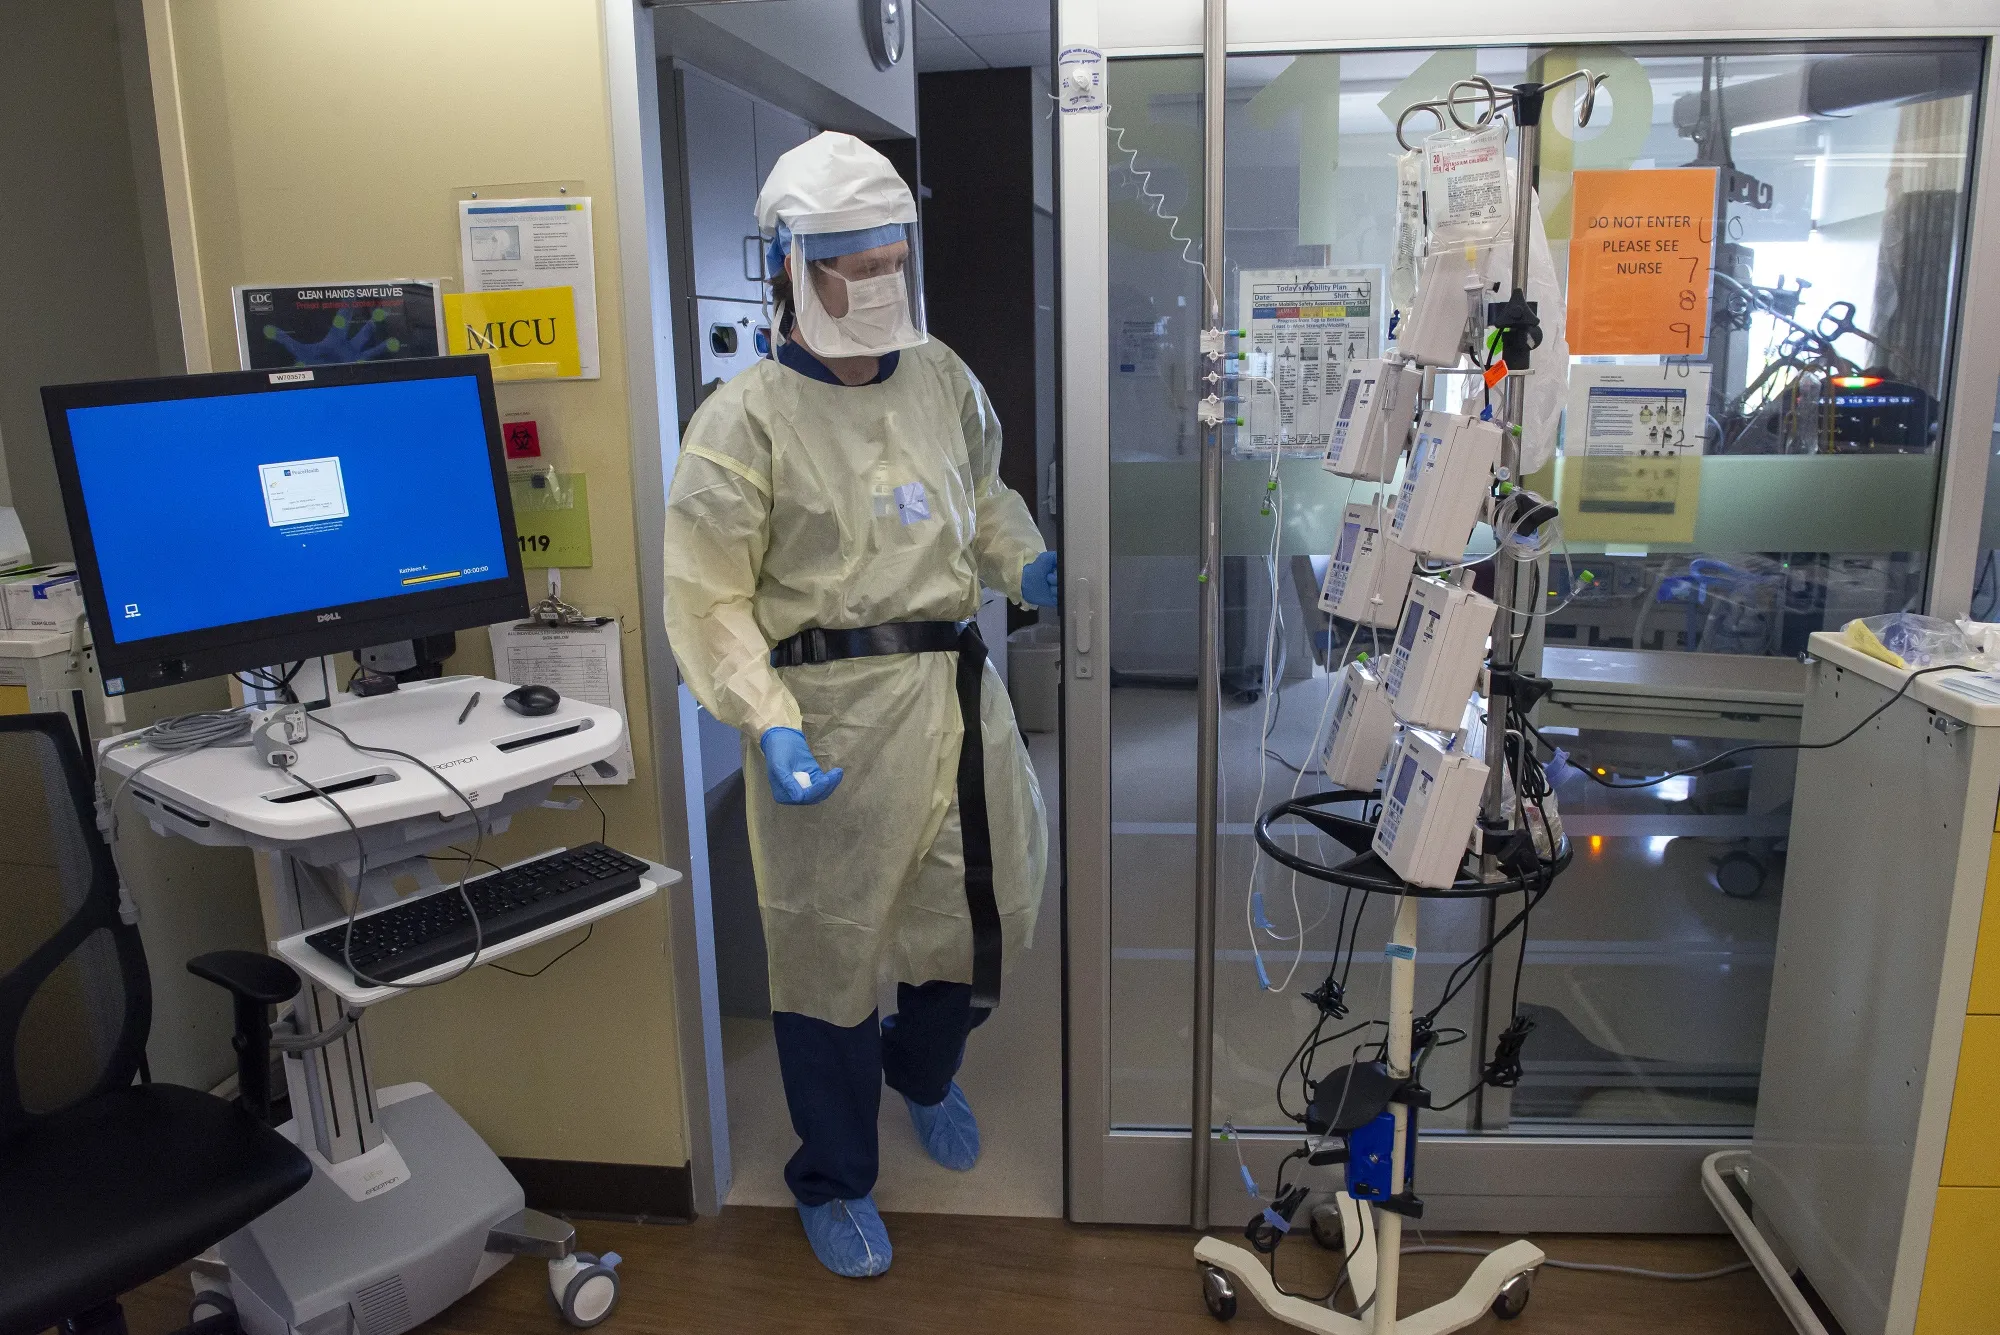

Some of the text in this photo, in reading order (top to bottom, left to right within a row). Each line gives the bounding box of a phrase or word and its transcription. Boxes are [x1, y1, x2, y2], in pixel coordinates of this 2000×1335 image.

[1589, 215, 1691, 228] DO NOT ENTER
[1603, 239, 1679, 252] PLEASE SEE
[1617, 262, 1663, 274] NURSE
[1679, 257, 1698, 283] 7
[250, 293, 271, 303] CDC
[297, 287, 403, 300] CLEAN HANDS SAVE LIVES
[1679, 289, 1696, 311] 8
[466, 317, 557, 351] MICU
[1669, 322, 1690, 348] 9
[518, 535, 551, 552] 119
[463, 565, 489, 575] 00:00:00
[317, 612, 341, 623] DELL
